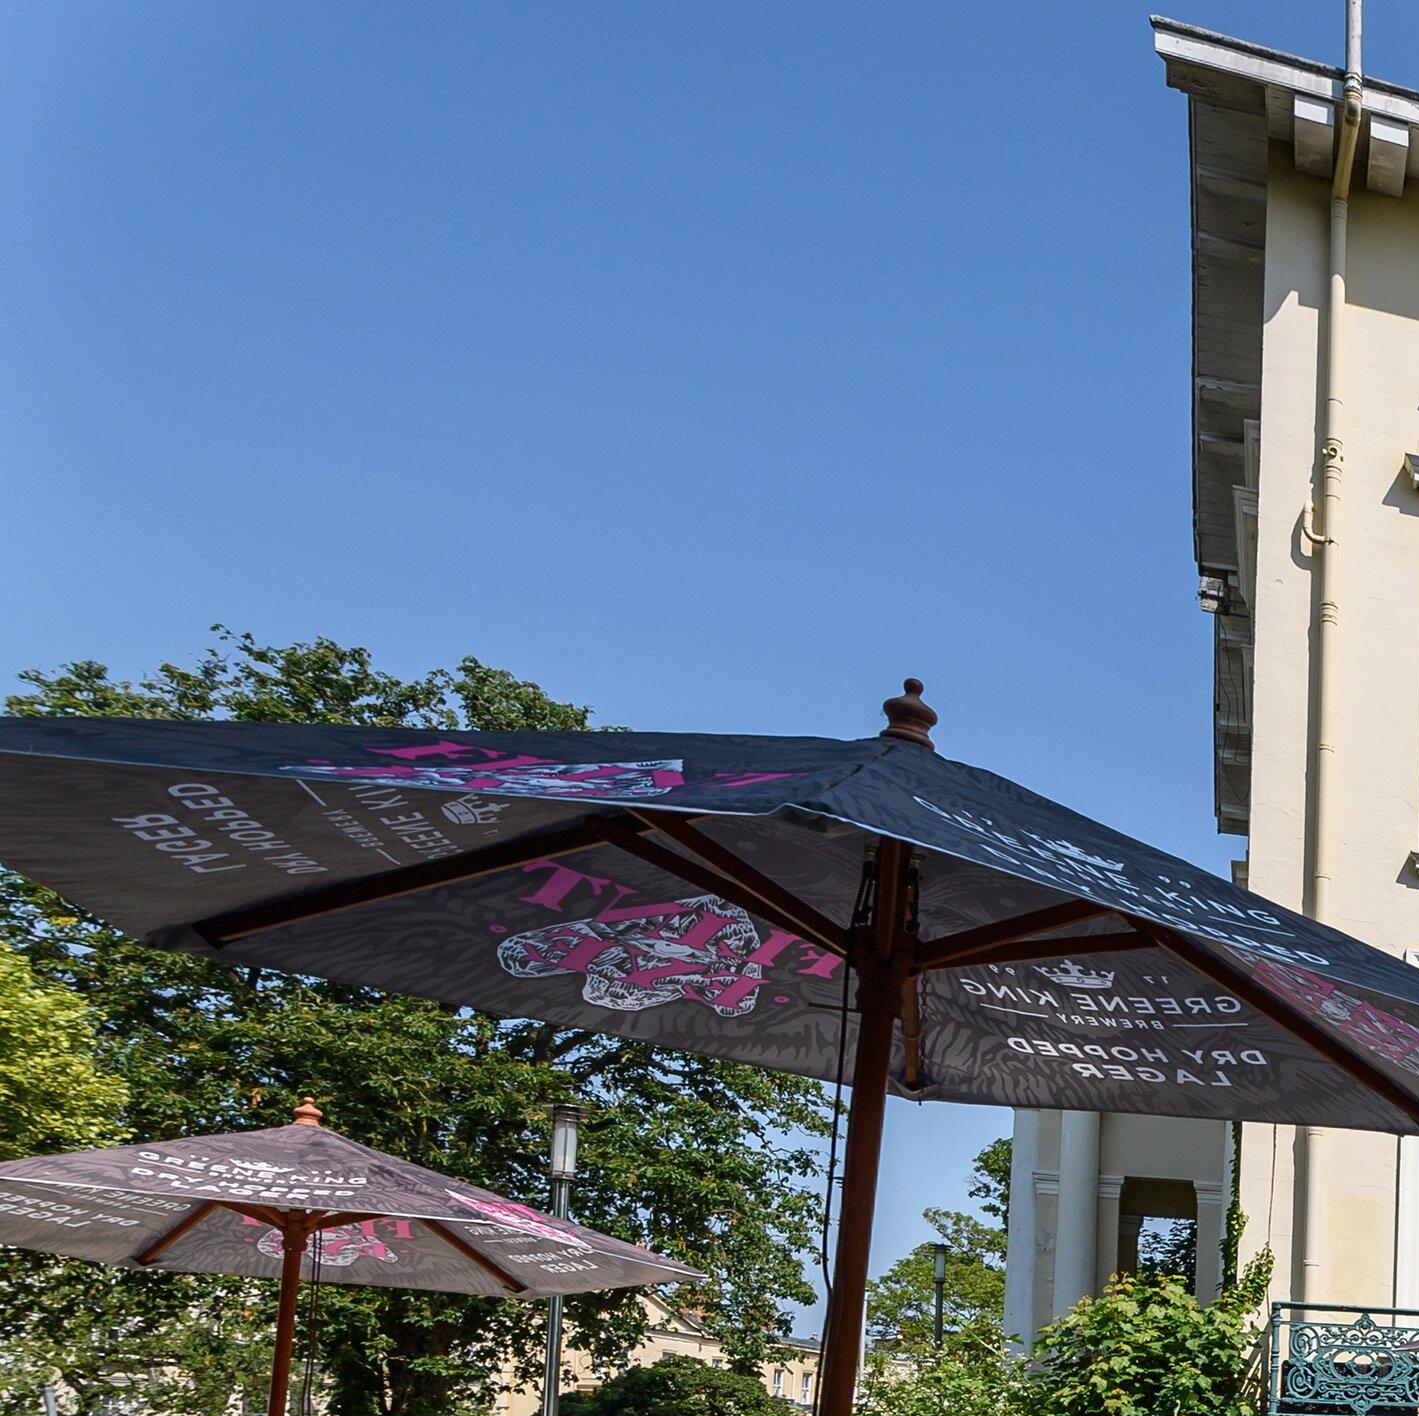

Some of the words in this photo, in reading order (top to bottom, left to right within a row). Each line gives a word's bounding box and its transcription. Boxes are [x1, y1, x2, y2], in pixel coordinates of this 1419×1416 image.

[913, 796, 1141, 891] GREENE
[1157, 886, 1281, 925] KING
[131, 1167, 204, 1183] DRY
[218, 1181, 355, 1197] HOPPED
[138, 1151, 276, 1179] GREENE
[290, 1174, 368, 1185] KING
[170, 1180, 310, 1200] LAGER
